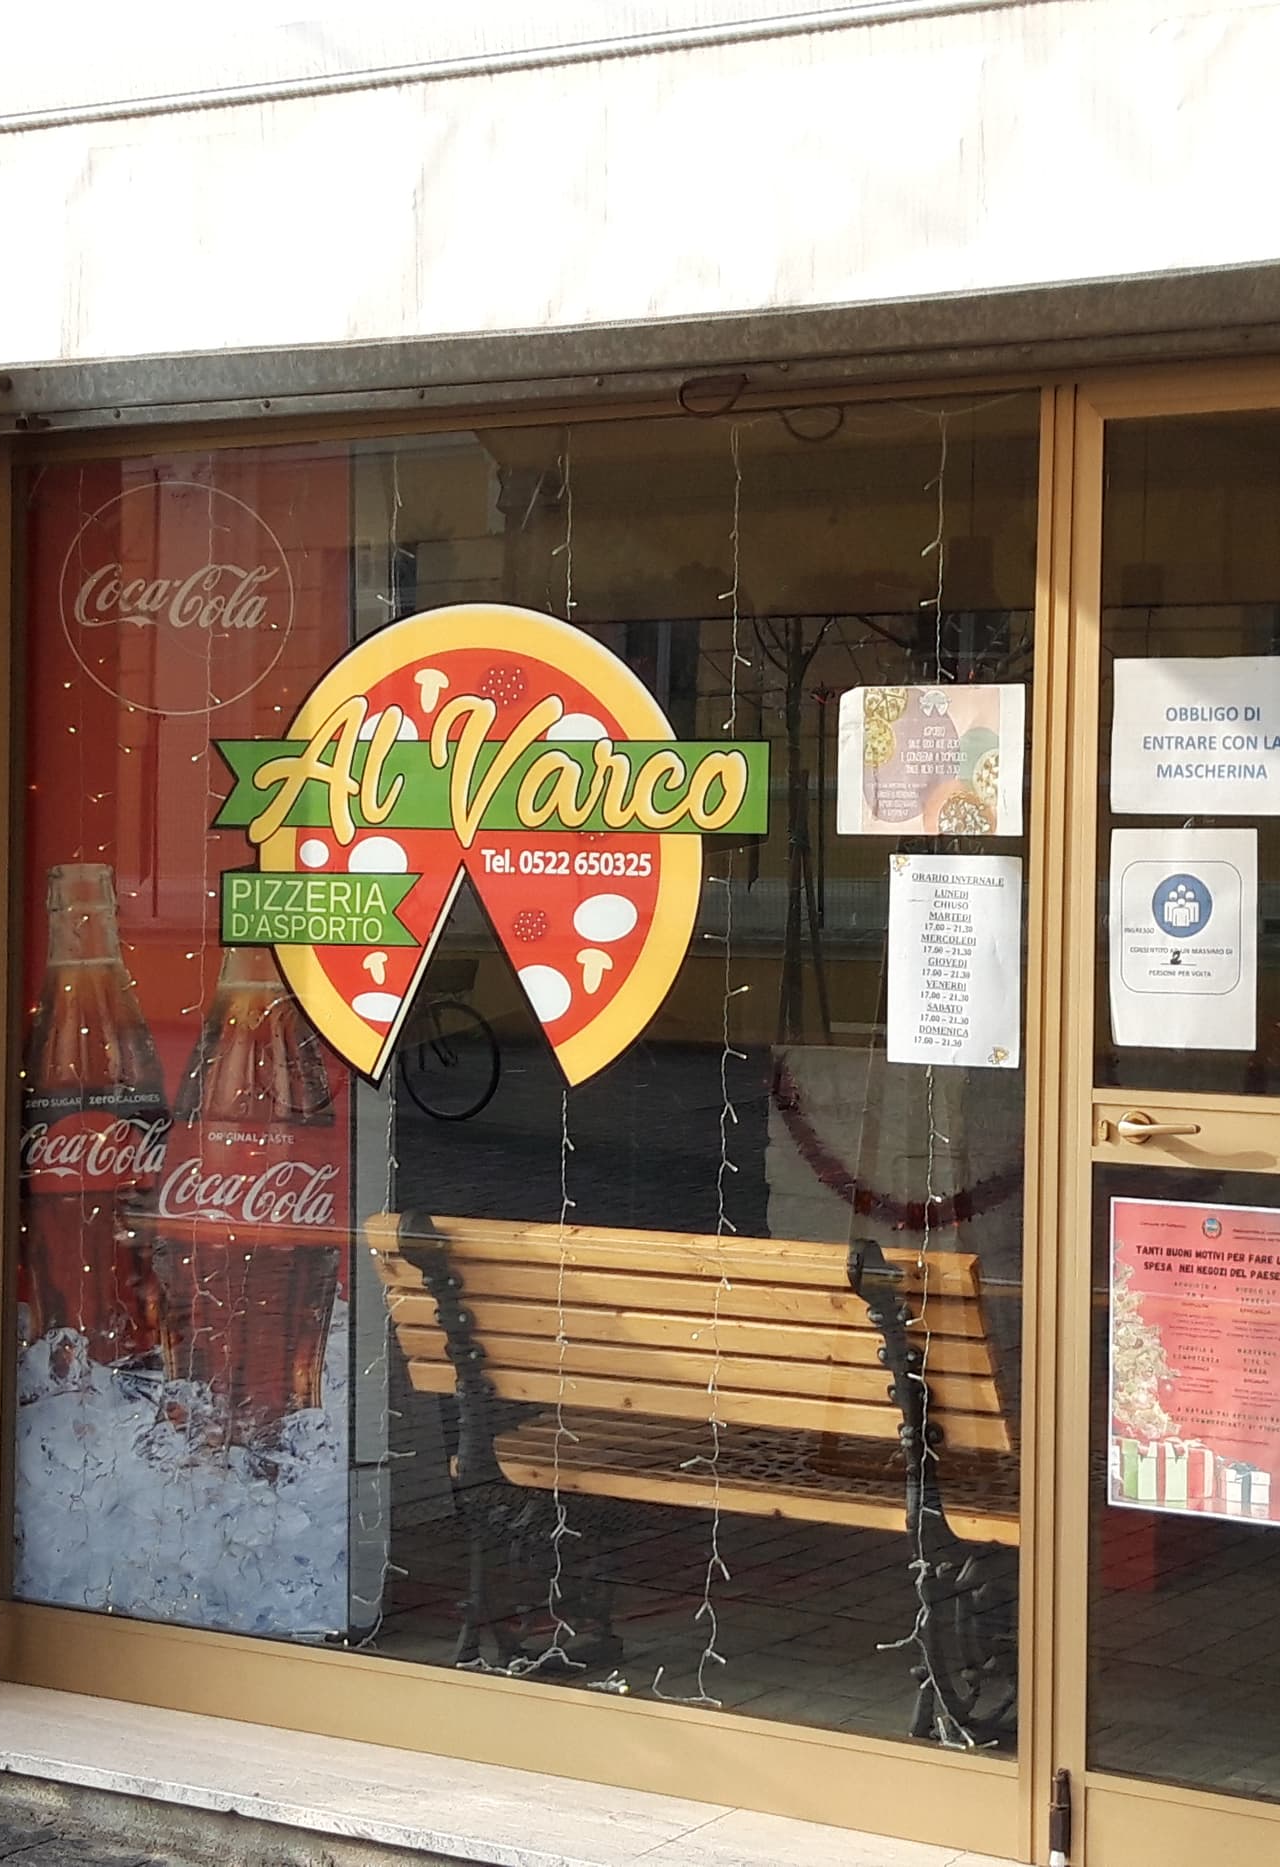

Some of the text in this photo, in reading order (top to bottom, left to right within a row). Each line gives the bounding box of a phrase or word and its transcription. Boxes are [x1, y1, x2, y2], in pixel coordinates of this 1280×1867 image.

[74, 563, 280, 628] Coca-Cola
[1166, 706, 1260, 722] OBBLIGO DI
[1143, 735, 1217, 750] ENTRARE
[1222, 735, 1258, 750] CON
[248, 694, 748, 849] Al Varco
[1156, 764, 1268, 779] MASCHERINA
[481, 849, 652, 877] Tel. 0522 650325
[912, 872, 1004, 887] ORARIO INVERNALE
[231, 878, 387, 914] PIZZERIA
[933, 901, 968, 909] CHIUSO
[231, 913, 383, 942] D'ASPORTO
[926, 1002, 963, 1014] SABATO
[919, 1025, 969, 1038] DOMENICA
[158, 1157, 340, 1225] Coca-Cola
[1136, 1245, 1163, 1255] TANTI
[1166, 1248, 1192, 1258] BUONI
[1195, 1250, 1224, 1261] MOTIVI
[1227, 1252, 1245, 1262] PER
[1248, 1254, 1273, 1265] FARE
[1143, 1261, 1280, 1281] SPESA NEI NEGOZI DEL PAESE
